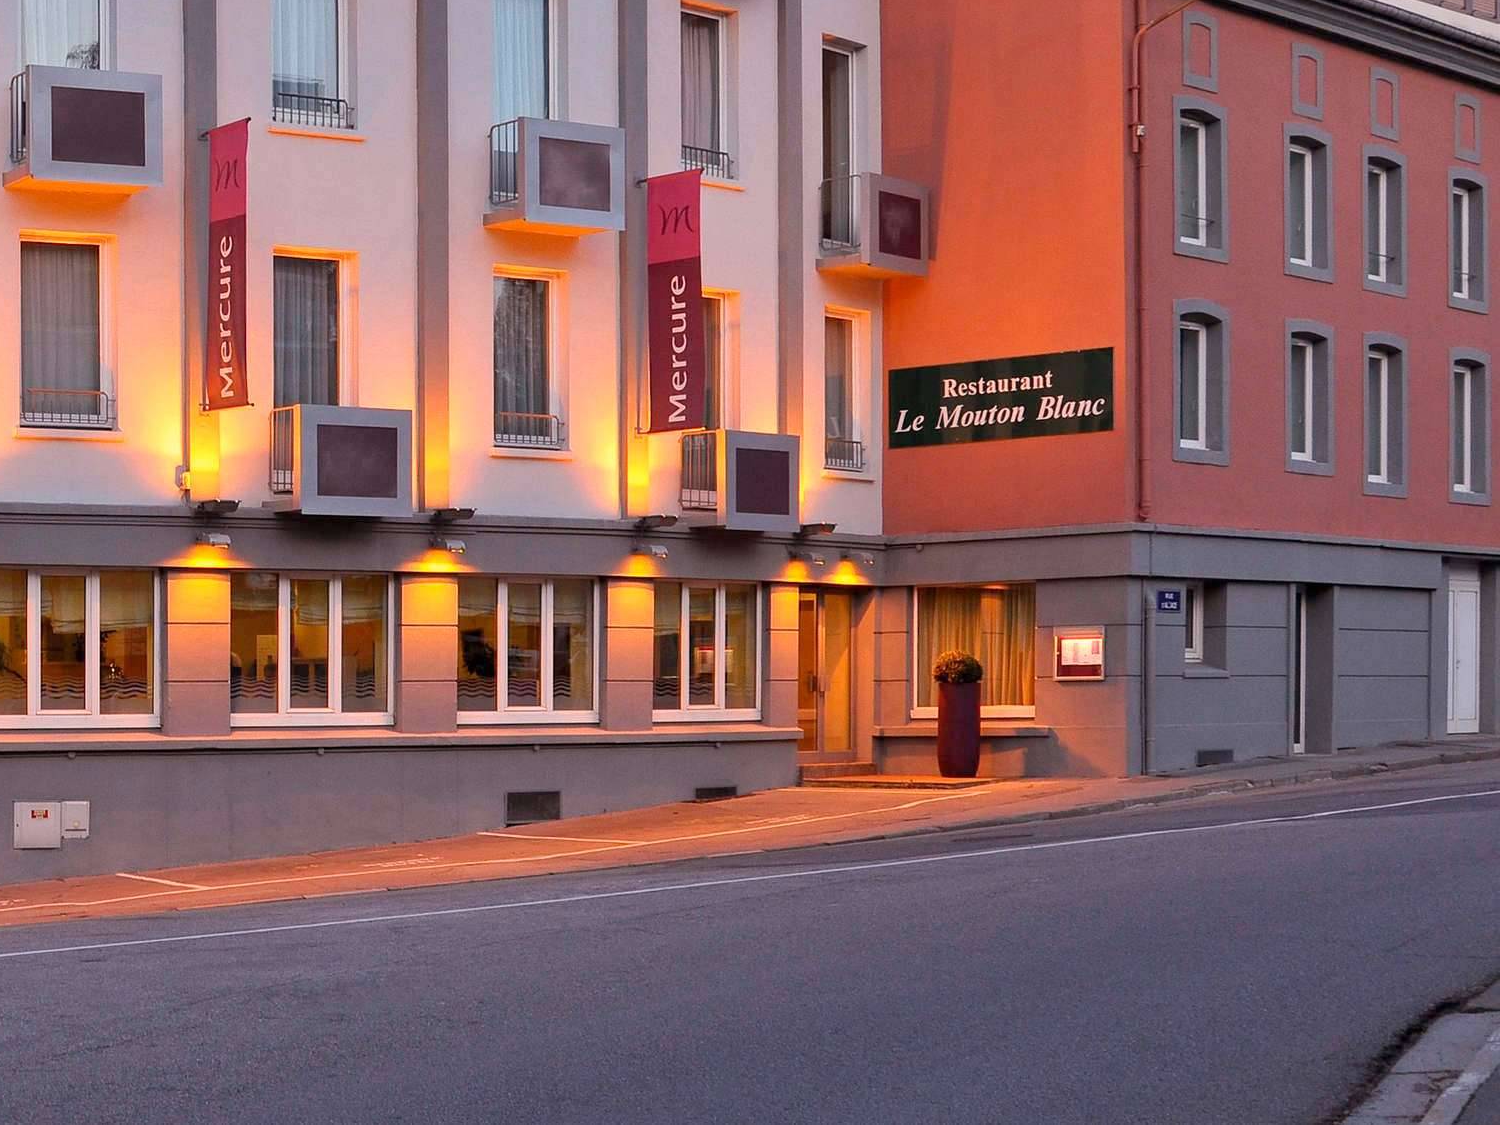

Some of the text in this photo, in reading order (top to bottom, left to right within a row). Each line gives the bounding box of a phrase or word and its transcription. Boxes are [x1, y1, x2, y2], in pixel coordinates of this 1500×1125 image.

[219, 235, 234, 398] Mercure
[668, 274, 687, 423] Mercure
[895, 395, 1106, 433] Le Mouton Blanc
[943, 370, 1053, 398] Restaurant
